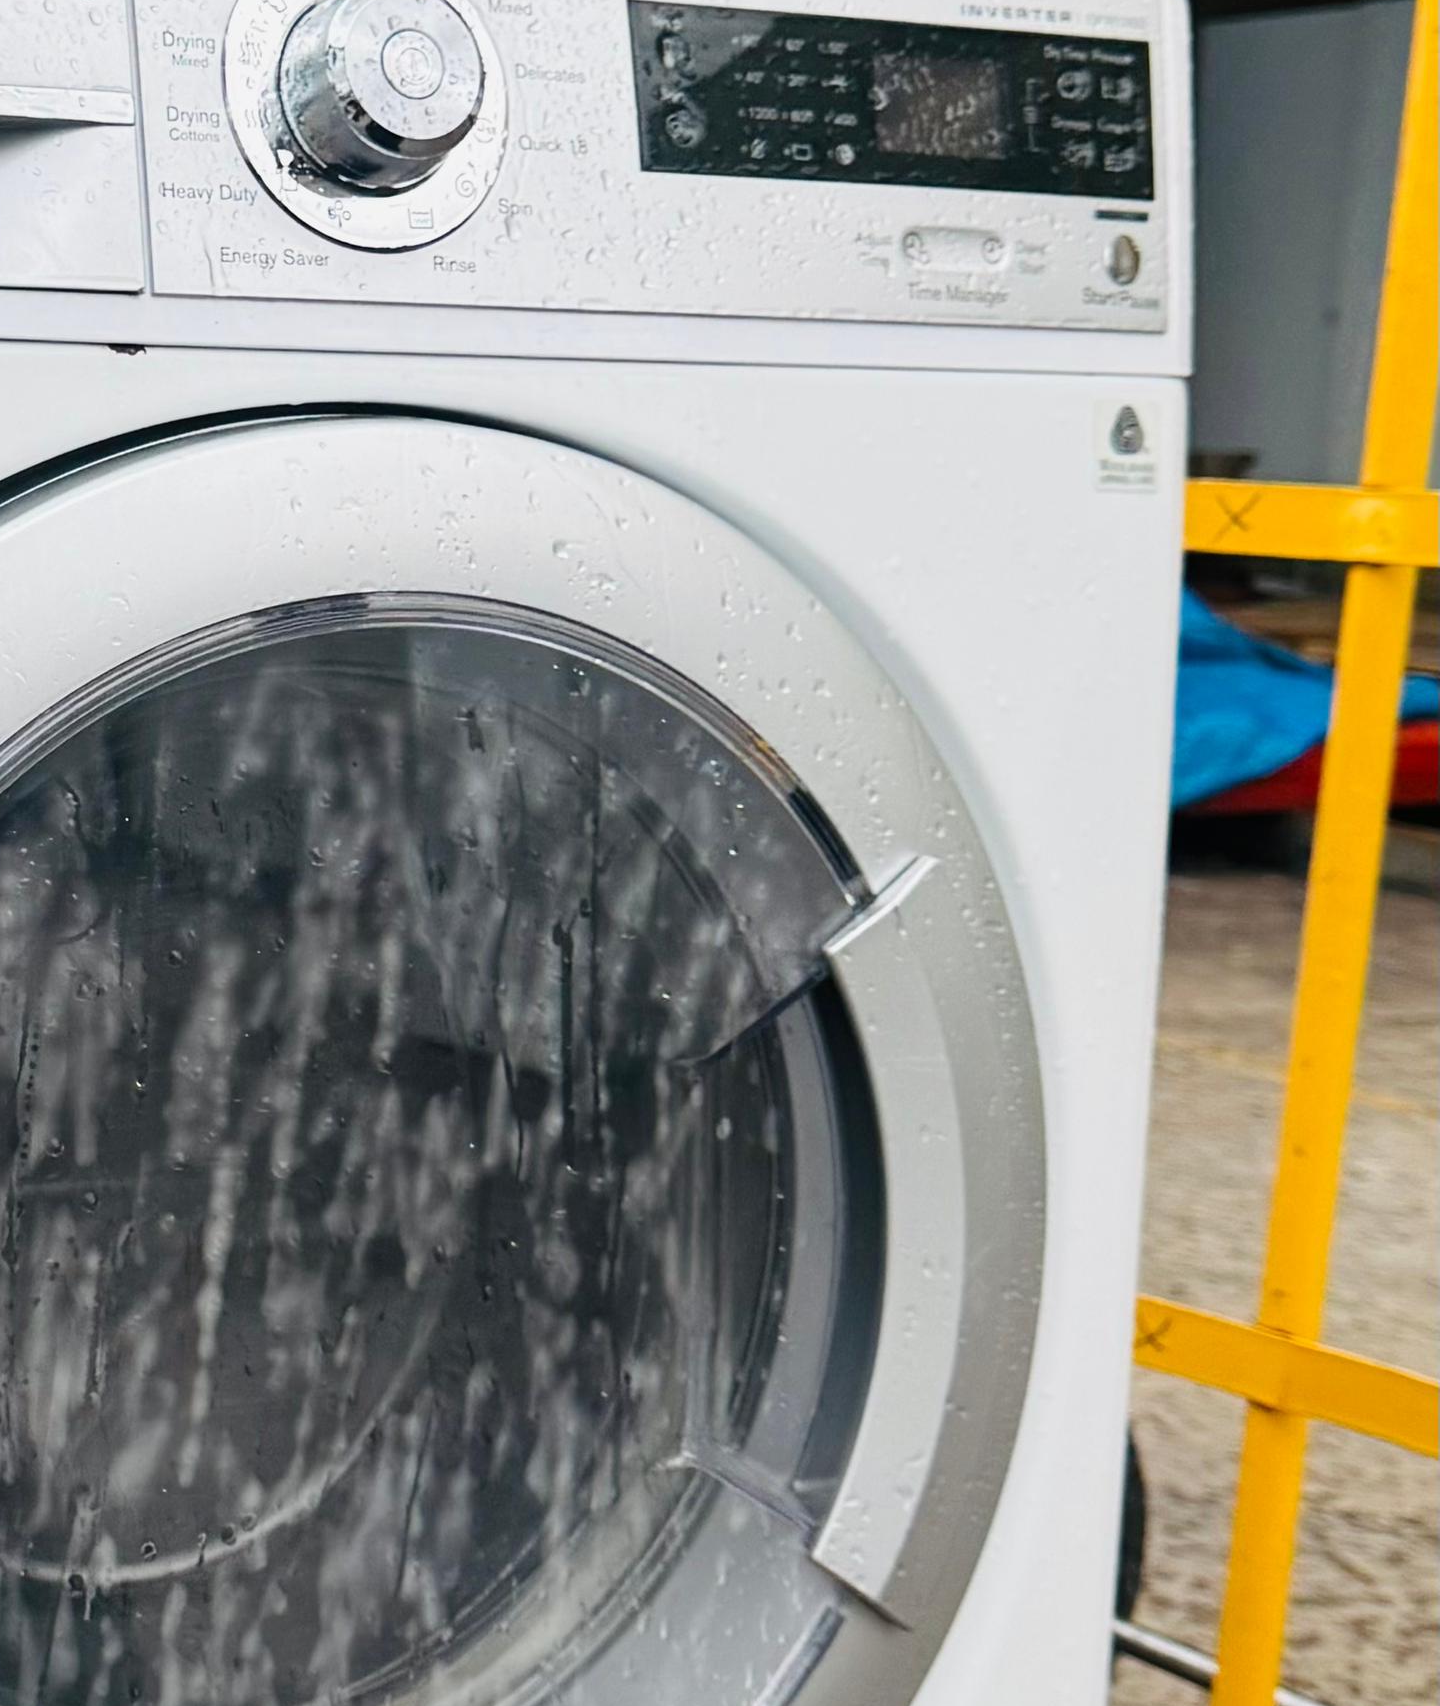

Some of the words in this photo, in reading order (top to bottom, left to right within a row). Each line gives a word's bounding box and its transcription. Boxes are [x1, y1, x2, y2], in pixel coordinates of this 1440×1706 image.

[163, 30, 216, 55] Drying
[166, 105, 220, 129] Drying
[161, 182, 213, 205] Heavy
[219, 184, 258, 207] Duty
[220, 246, 278, 270] Energy
[283, 248, 330, 267] Saver
[433, 255, 477, 274] Rinse
